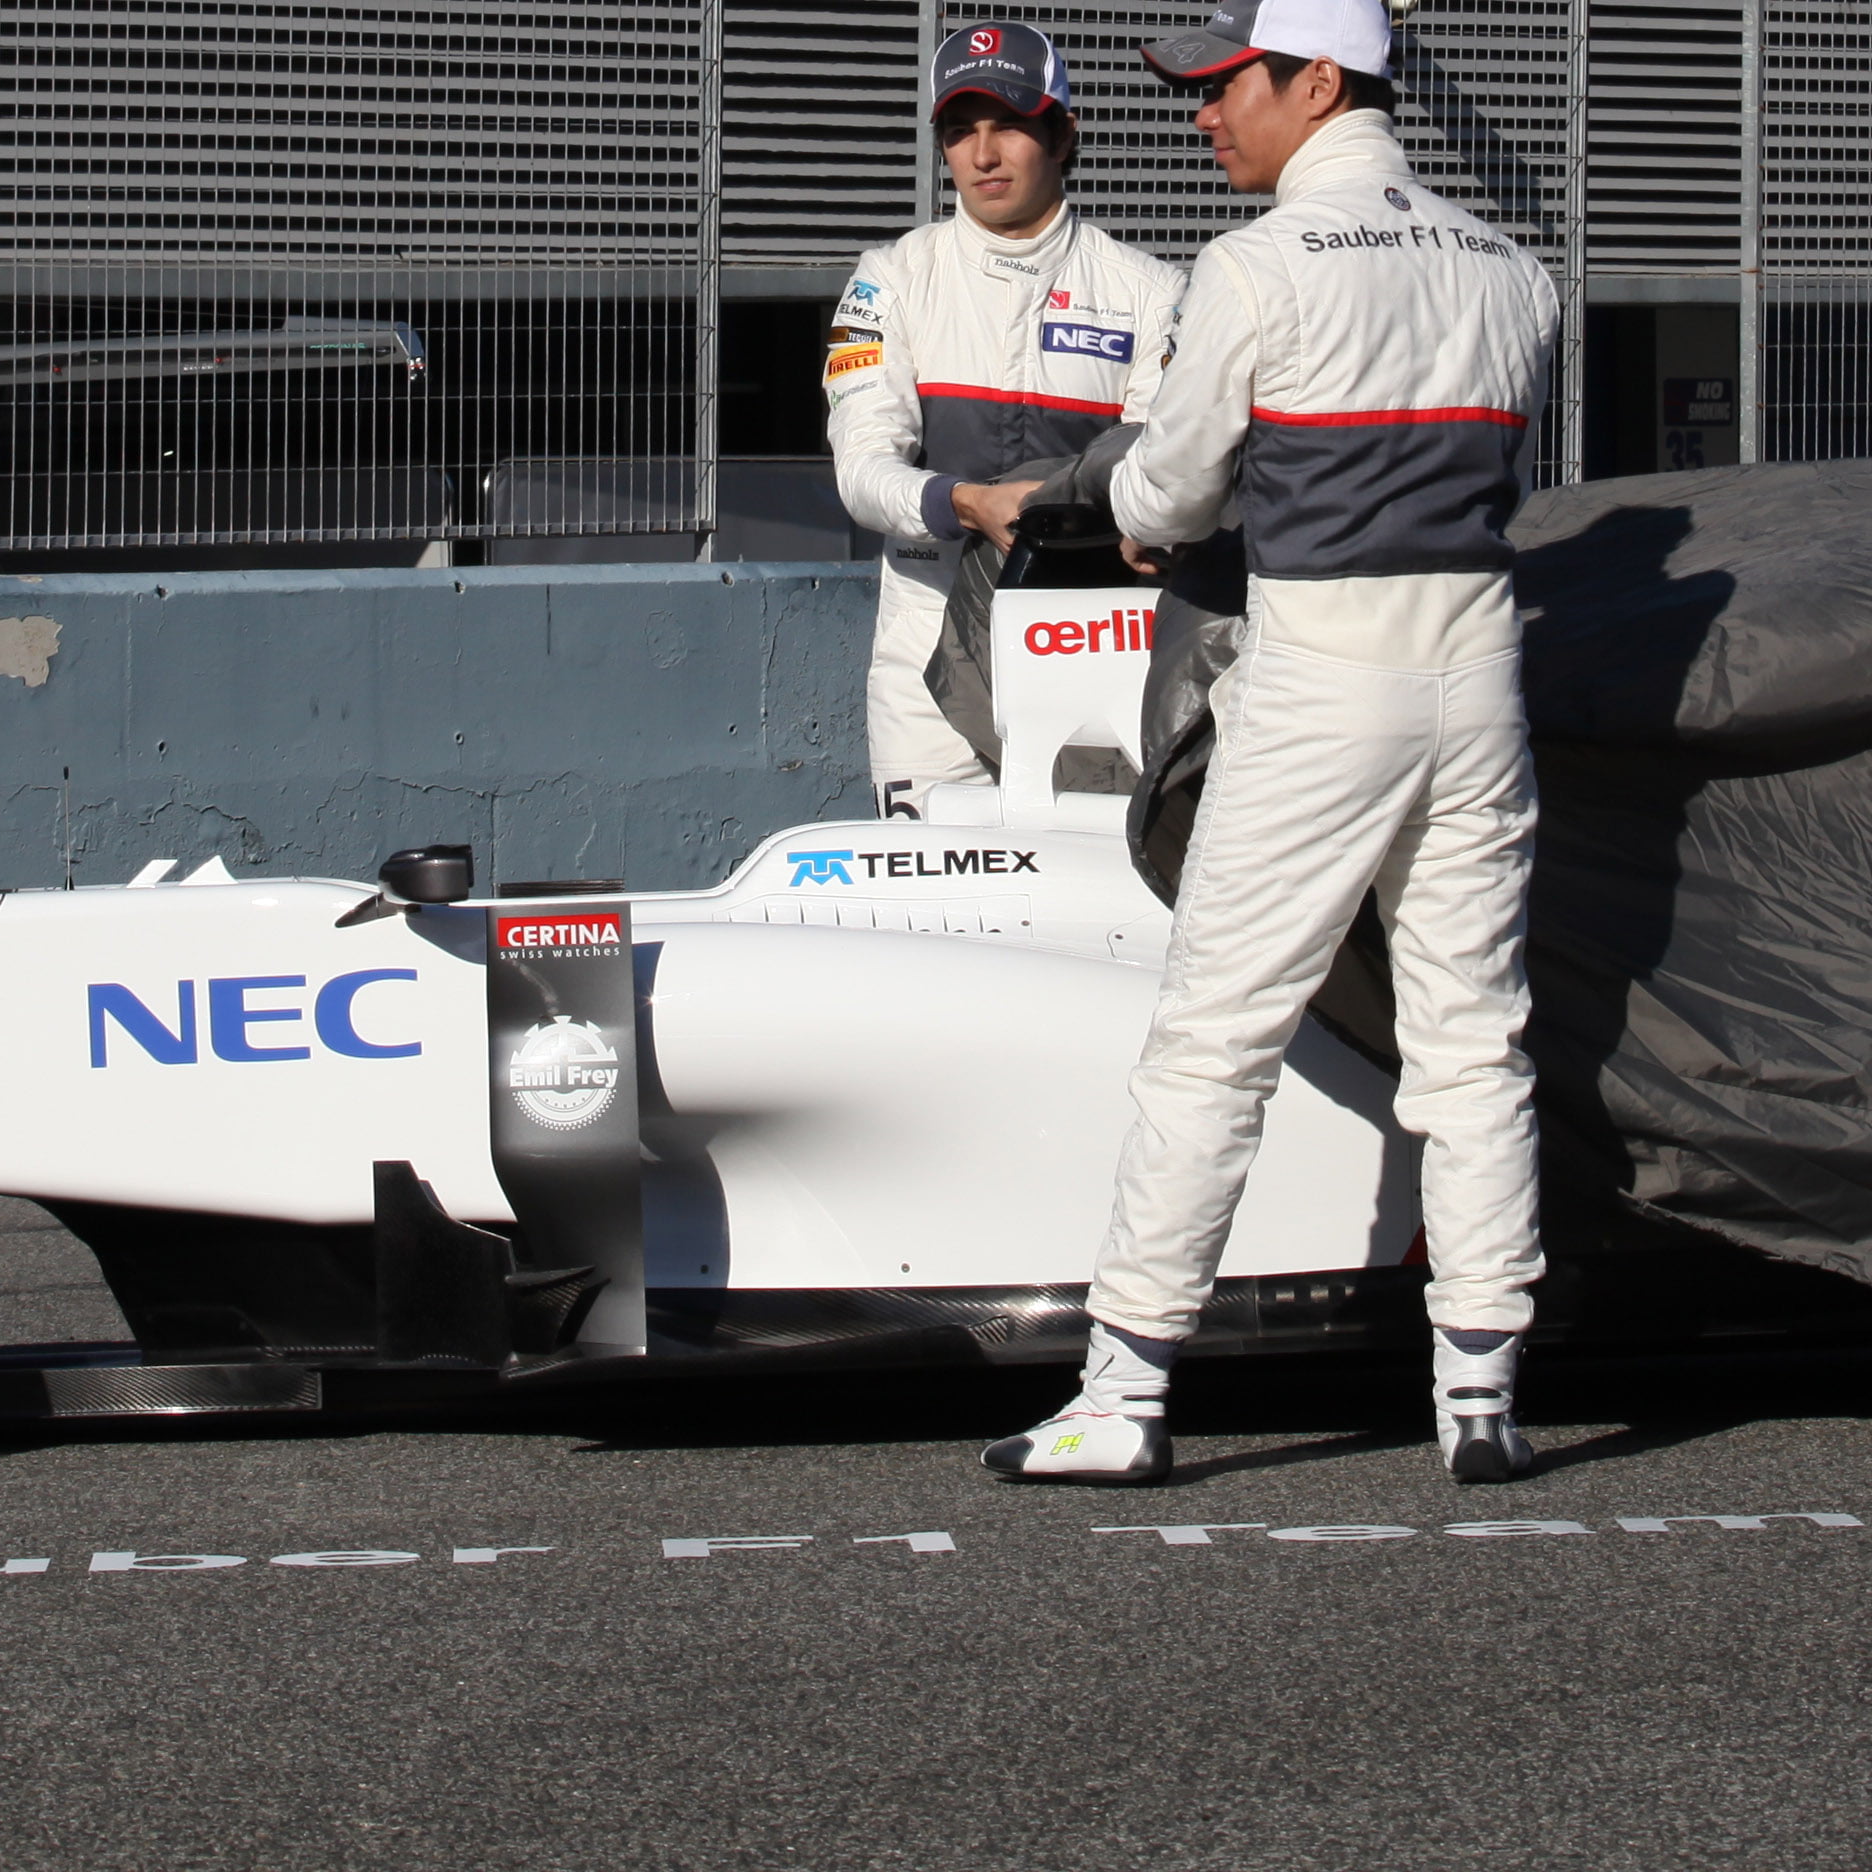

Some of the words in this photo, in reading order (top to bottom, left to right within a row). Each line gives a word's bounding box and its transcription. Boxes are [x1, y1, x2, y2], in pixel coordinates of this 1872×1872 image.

[944, 60, 977, 79] Sauber
[979, 58, 992, 68] F1
[996, 59, 1025, 75] Team
[1300, 224, 1404, 253] Sauber
[1410, 225, 1443, 249] F1
[1447, 227, 1512, 260] Team
[994, 257, 1040, 276] nabholz
[838, 303, 883, 325] ELMEX
[1052, 327, 1126, 357] NEC
[1695, 380, 1725, 400] NO
[896, 547, 940, 561] nabholz
[858, 850, 1040, 878] TELMEX
[507, 923, 620, 947] CERTINA
[500, 949, 543, 960] swiss
[552, 946, 620, 958] watches
[87, 968, 422, 1068] NEC
[509, 1064, 561, 1087] Emil
[567, 1065, 619, 1089] Frey
[661, 1531, 958, 1558] F1
[1091, 1512, 1866, 1545] Team
